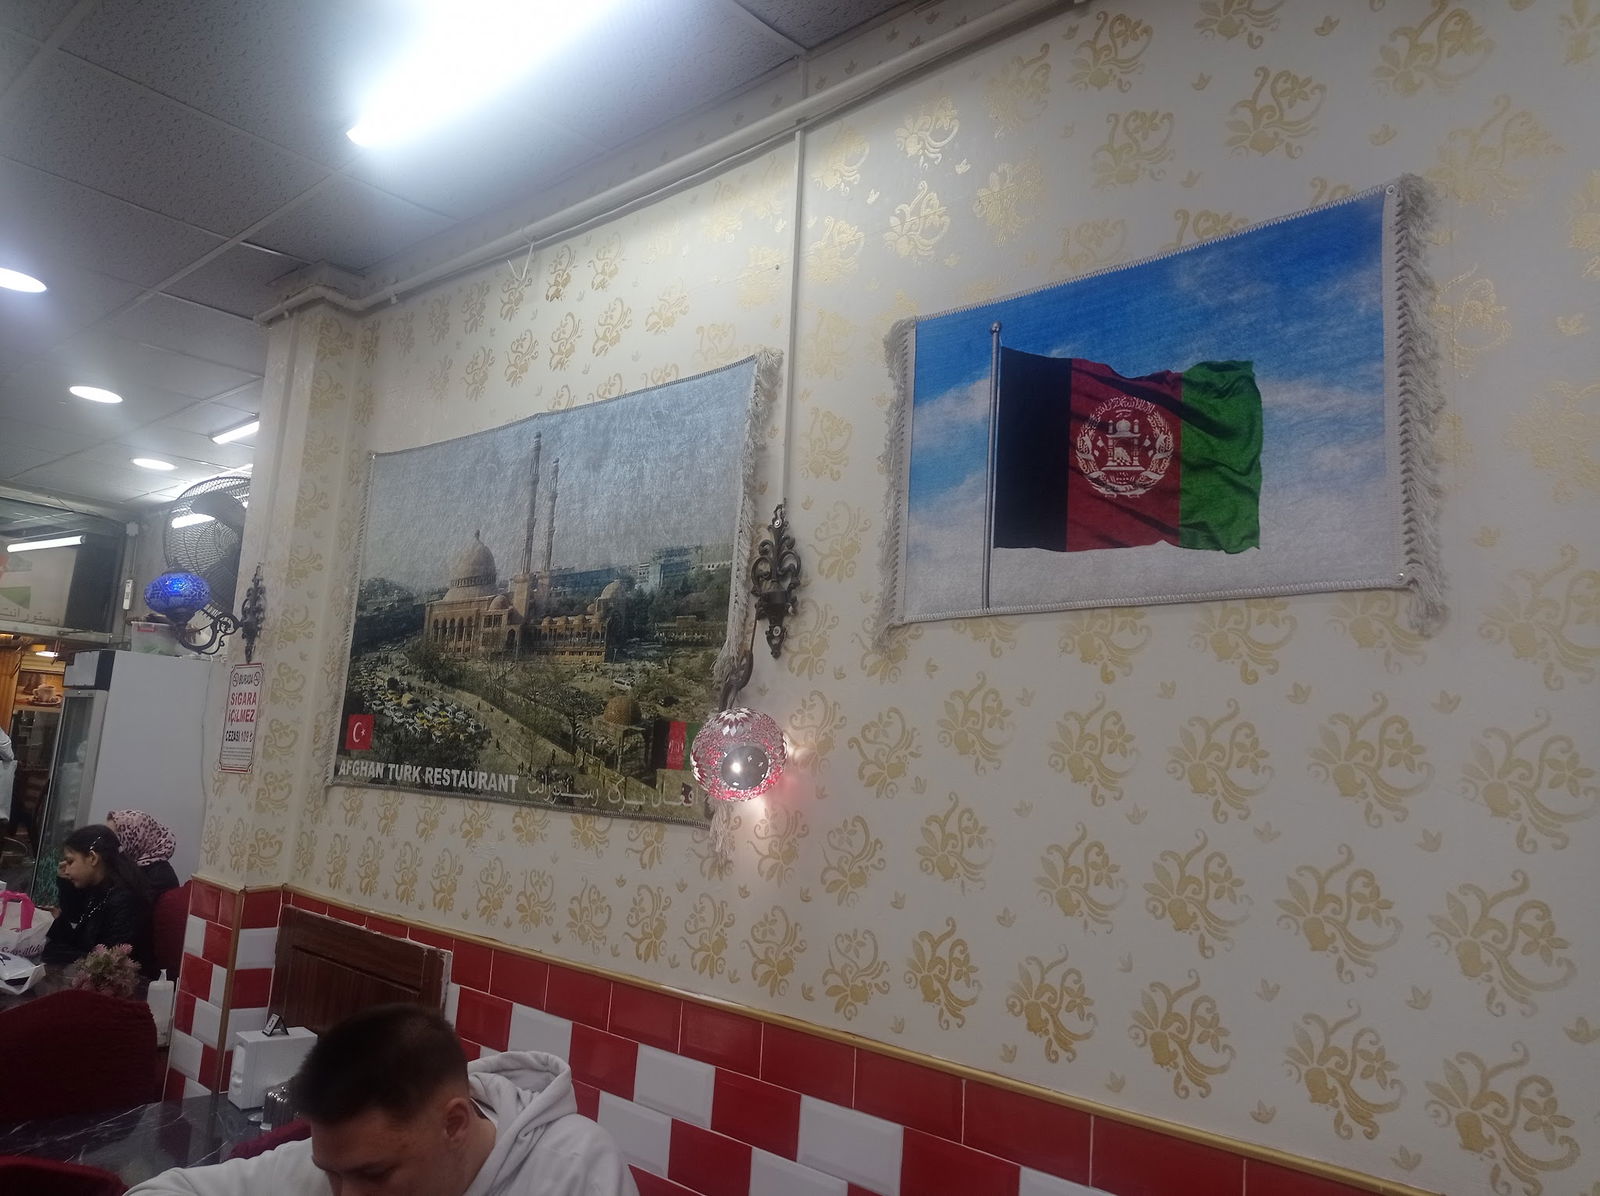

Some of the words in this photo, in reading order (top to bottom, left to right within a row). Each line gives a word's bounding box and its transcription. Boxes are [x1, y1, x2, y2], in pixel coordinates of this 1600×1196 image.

[225, 730, 240, 742] CEZASI
[338, 759, 385, 778] AFGHAN
[388, 763, 422, 784] TURK
[425, 768, 519, 794] RESTAURANT
